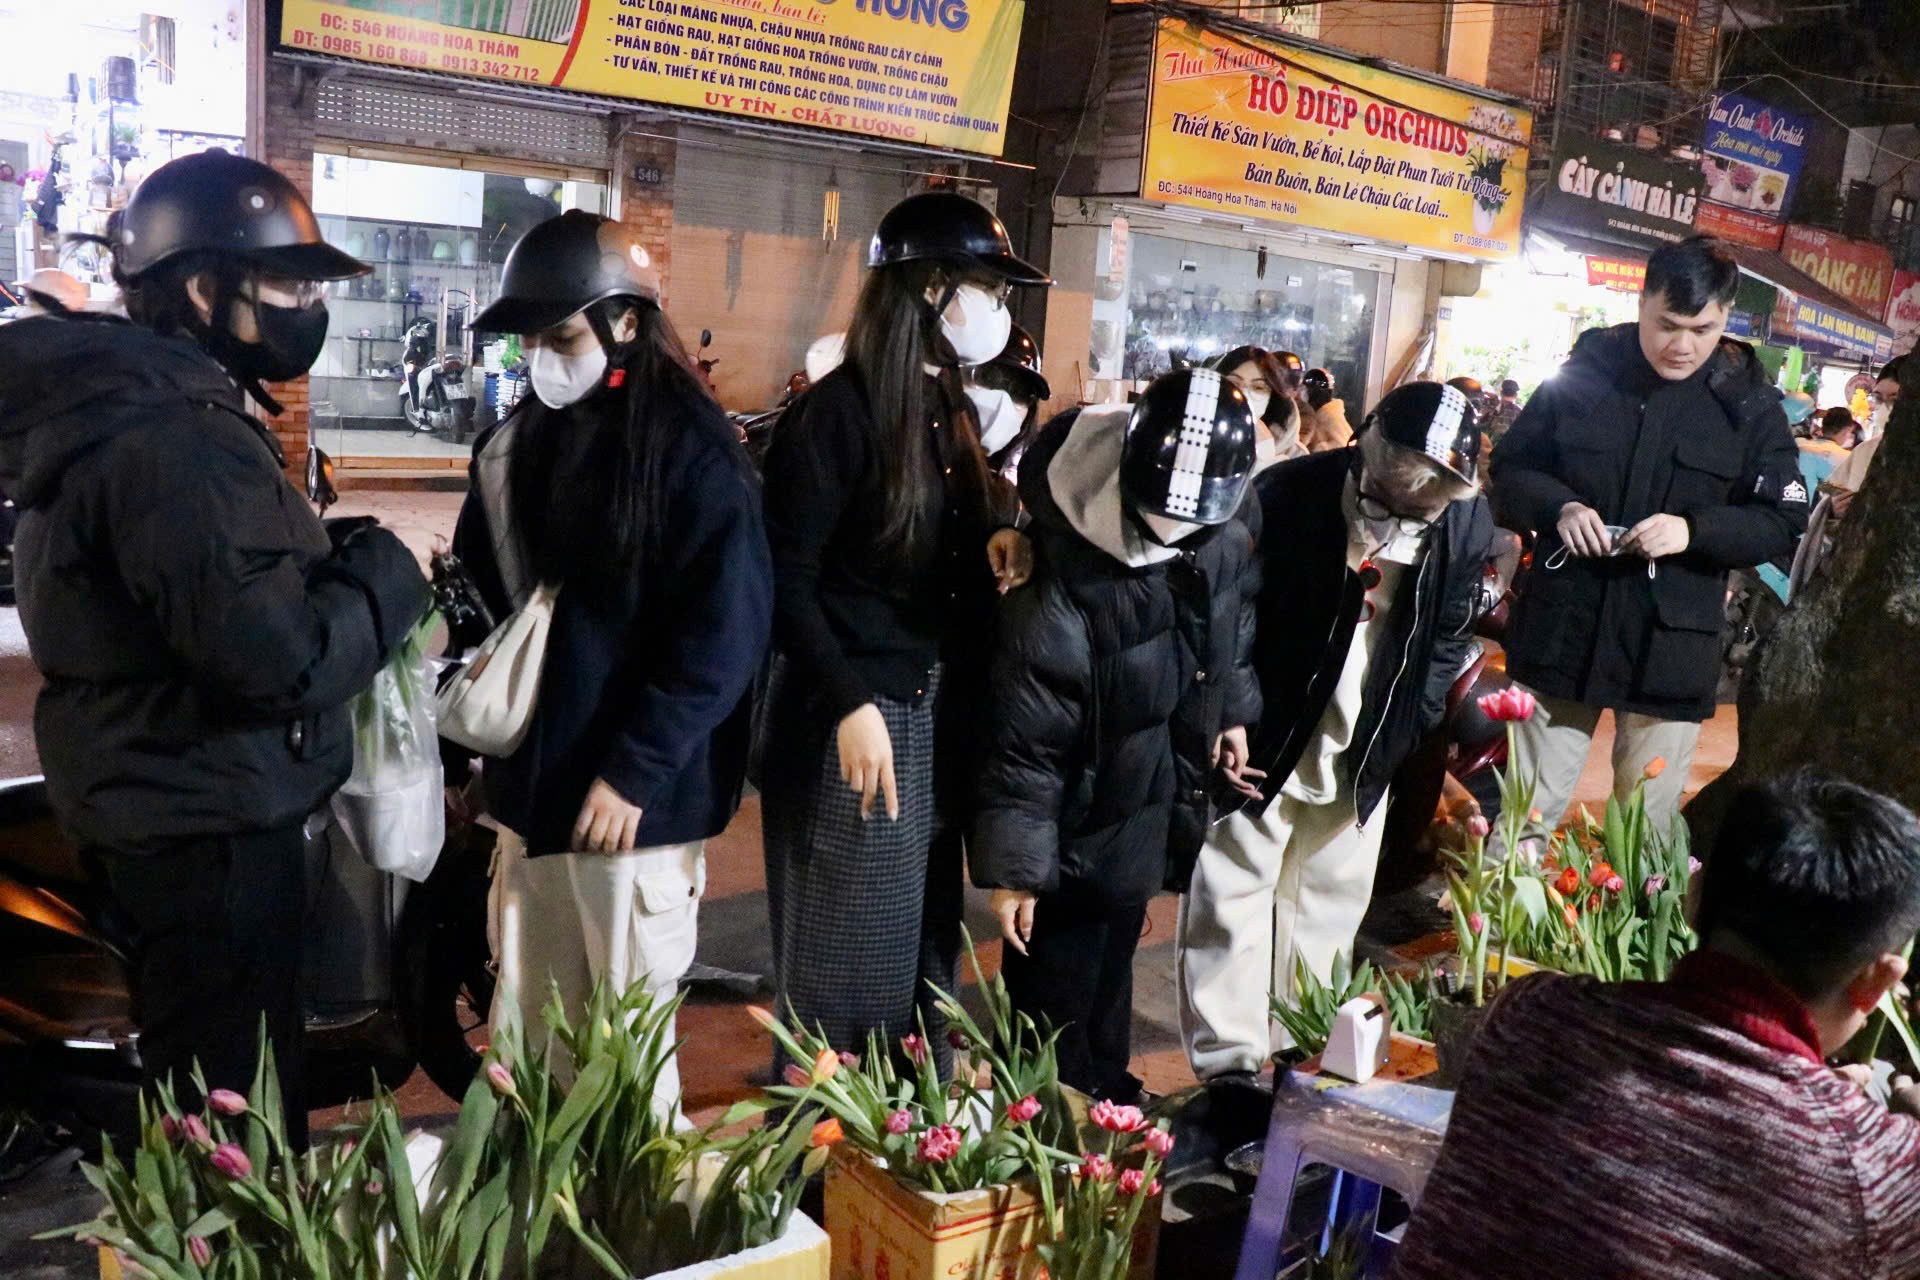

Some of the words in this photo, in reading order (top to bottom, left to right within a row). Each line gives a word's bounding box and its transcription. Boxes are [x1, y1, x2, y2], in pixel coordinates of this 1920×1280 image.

[352, 19, 382, 37] 546
[443, 33, 473, 51] HOA
[614, 34, 651, 52] PHÂN
[690, 46, 715, 63] ĐẤT
[617, 13, 642, 30] HẠT
[645, 18, 684, 37] GIỐNG
[718, 32, 741, 49] HẠT
[743, 36, 780, 55] GIỐNG
[783, 45, 805, 60] HOA
[920, 72, 949, 88] CHẬU
[648, 0, 677, 16] LOẠI
[760, 20, 792, 38] CHẬU
[794, 28, 826, 46] NHỰA
[867, 43, 889, 57] RAU
[890, 47, 912, 61] CÂY
[914, 50, 943, 68] CẢNH
[322, 35, 362, 55] 0985
[368, 43, 395, 60] 160
[442, 54, 479, 72] 0913
[482, 60, 509, 78] 342
[513, 65, 540, 81] 712
[1163, 52, 1203, 78] Thu
[613, 55, 630, 69] TƯ
[665, 63, 699, 80] THIẾT
[701, 68, 719, 84] KẾ
[738, 76, 757, 90] THI
[759, 79, 791, 96] CÔNG
[819, 90, 850, 107] CÔNG
[972, 119, 1000, 133] QUAN
[704, 91, 736, 108] UY
[740, 96, 777, 116] TÍN
[791, 105, 847, 127] CHẤT
[851, 116, 917, 139] LƯỢNG
[1295, 83, 1358, 137] ĐIỆP
[1364, 103, 1469, 157] ORCHIDS
[1727, 103, 1756, 132] Oanh
[1769, 117, 1805, 147] Orchids
[1172, 112, 1209, 138] Thiết
[1211, 120, 1233, 142] Kế
[1231, 125, 1259, 148] Sân
[1261, 131, 1299, 158] Vườn,
[1320, 144, 1345, 168] Koi,
[1396, 160, 1428, 183] Phun
[638, 167, 659, 182] 546
[1177, 184, 1193, 196] 544
[1225, 192, 1242, 205] Hoa
[1244, 162, 1273, 185] Bán
[1274, 168, 1312, 194] Buôn,
[1315, 175, 1341, 197] Bán
[1359, 185, 1391, 210] Chậu
[1392, 191, 1415, 211] Các
[1558, 155, 1600, 198] CÂY
[1597, 161, 1650, 212] CẢNH
[1671, 187, 1697, 225] LÊ
[1797, 304, 1816, 325] HOA
